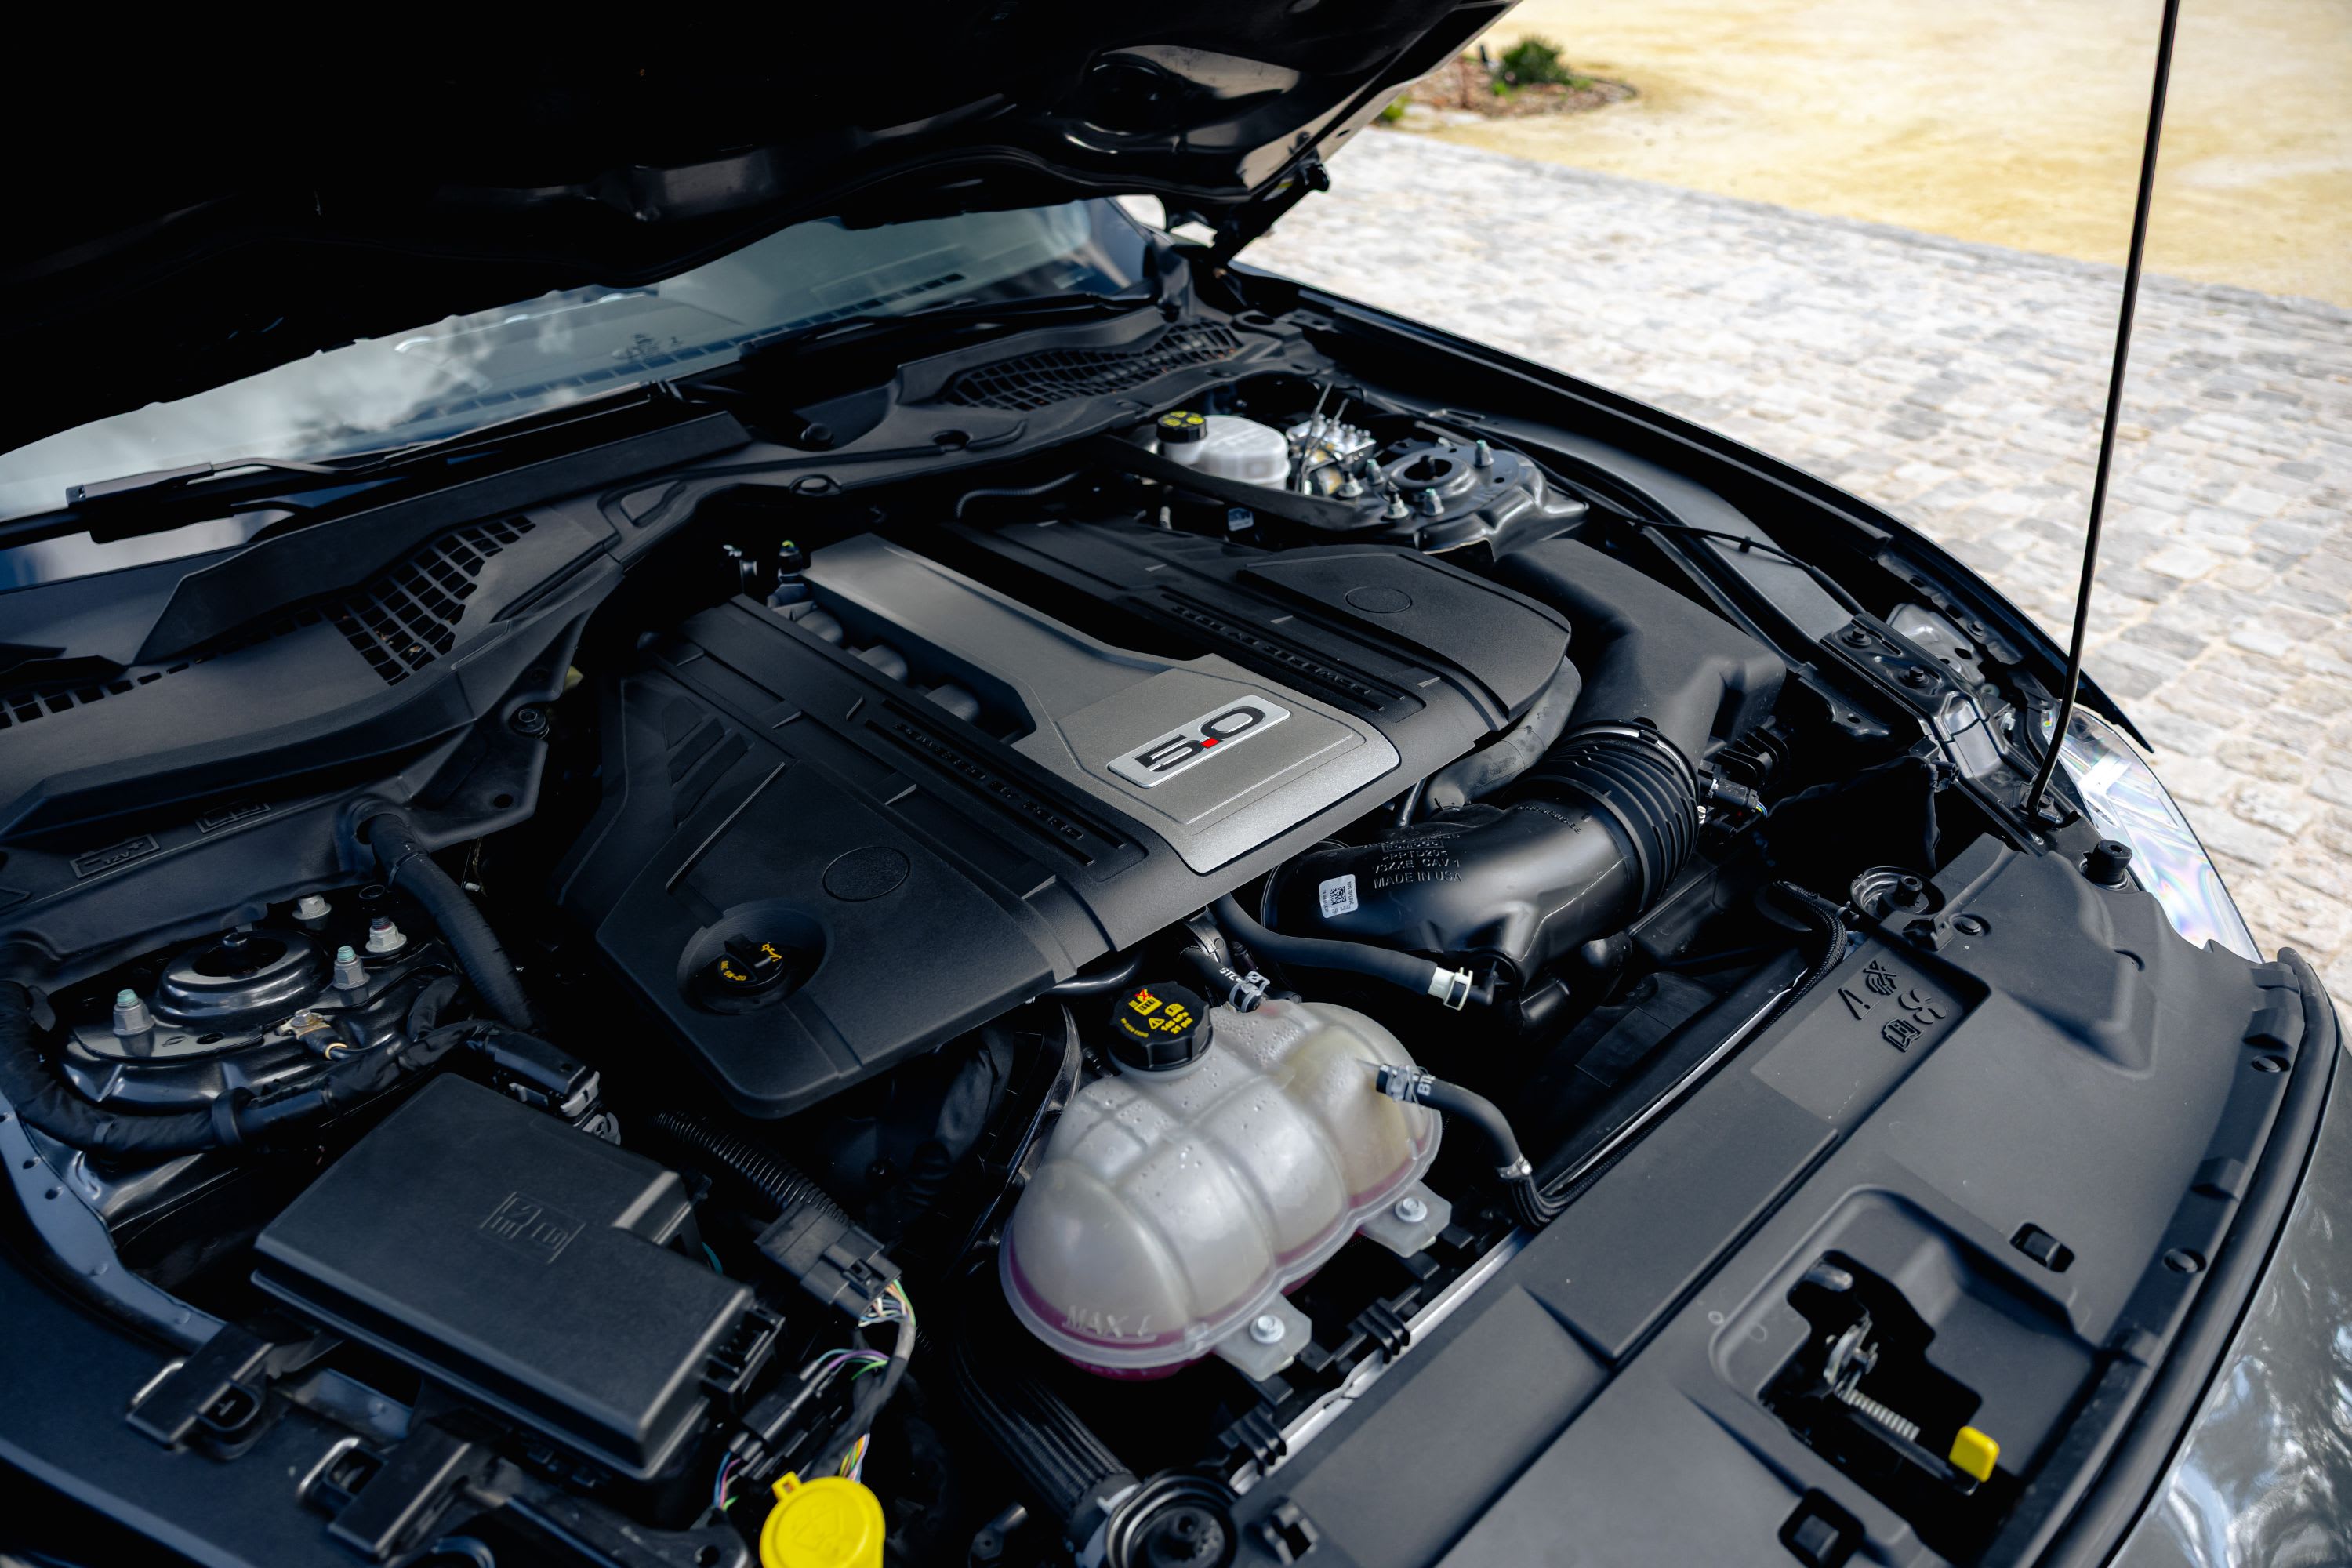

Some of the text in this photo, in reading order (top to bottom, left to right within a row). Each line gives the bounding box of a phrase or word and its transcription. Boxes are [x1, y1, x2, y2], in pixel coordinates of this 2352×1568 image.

[1134, 706, 1266, 772] 5.0
[1374, 870, 1462, 889] MADE IN USA
[1065, 1305, 1131, 1338] MAX
